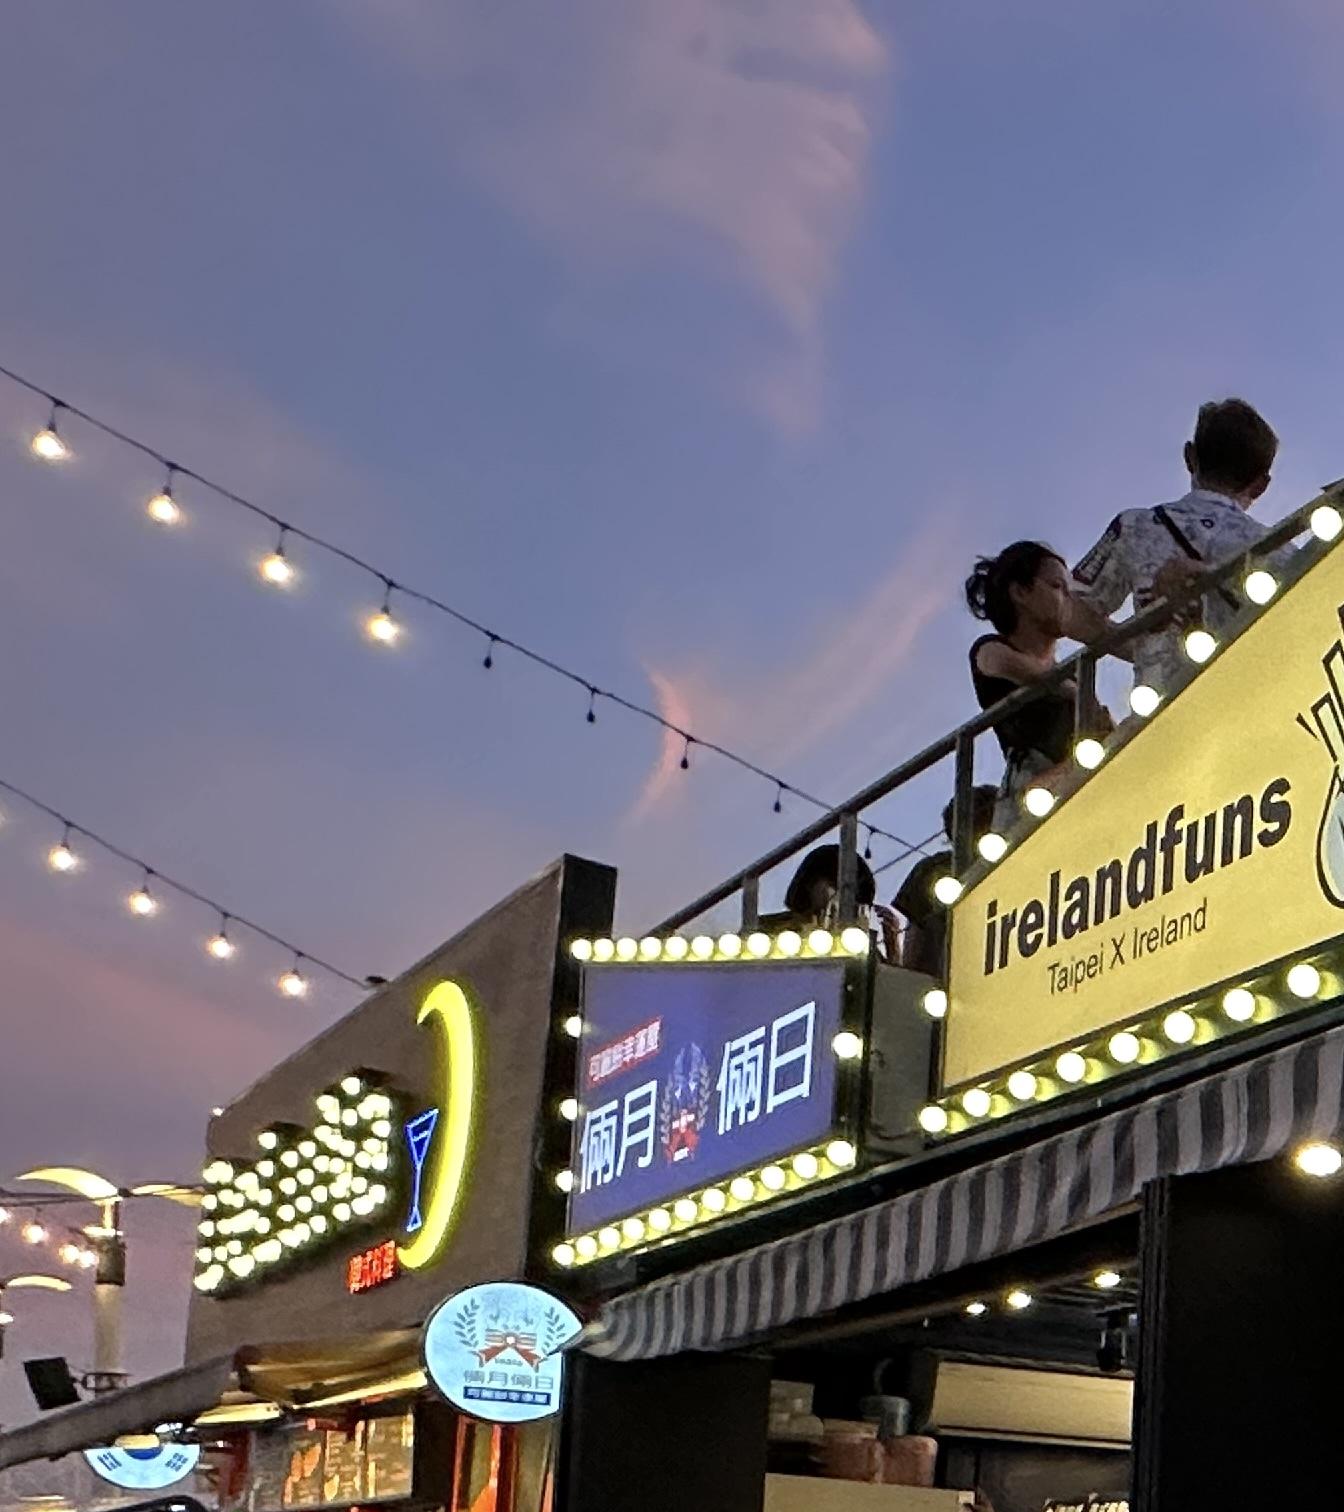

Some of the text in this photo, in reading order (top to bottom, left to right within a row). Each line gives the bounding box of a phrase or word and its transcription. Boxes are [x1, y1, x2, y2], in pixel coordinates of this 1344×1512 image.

[983, 777, 1292, 976] irelandfuns
[1047, 897, 1208, 995] Taipei X Ireland
